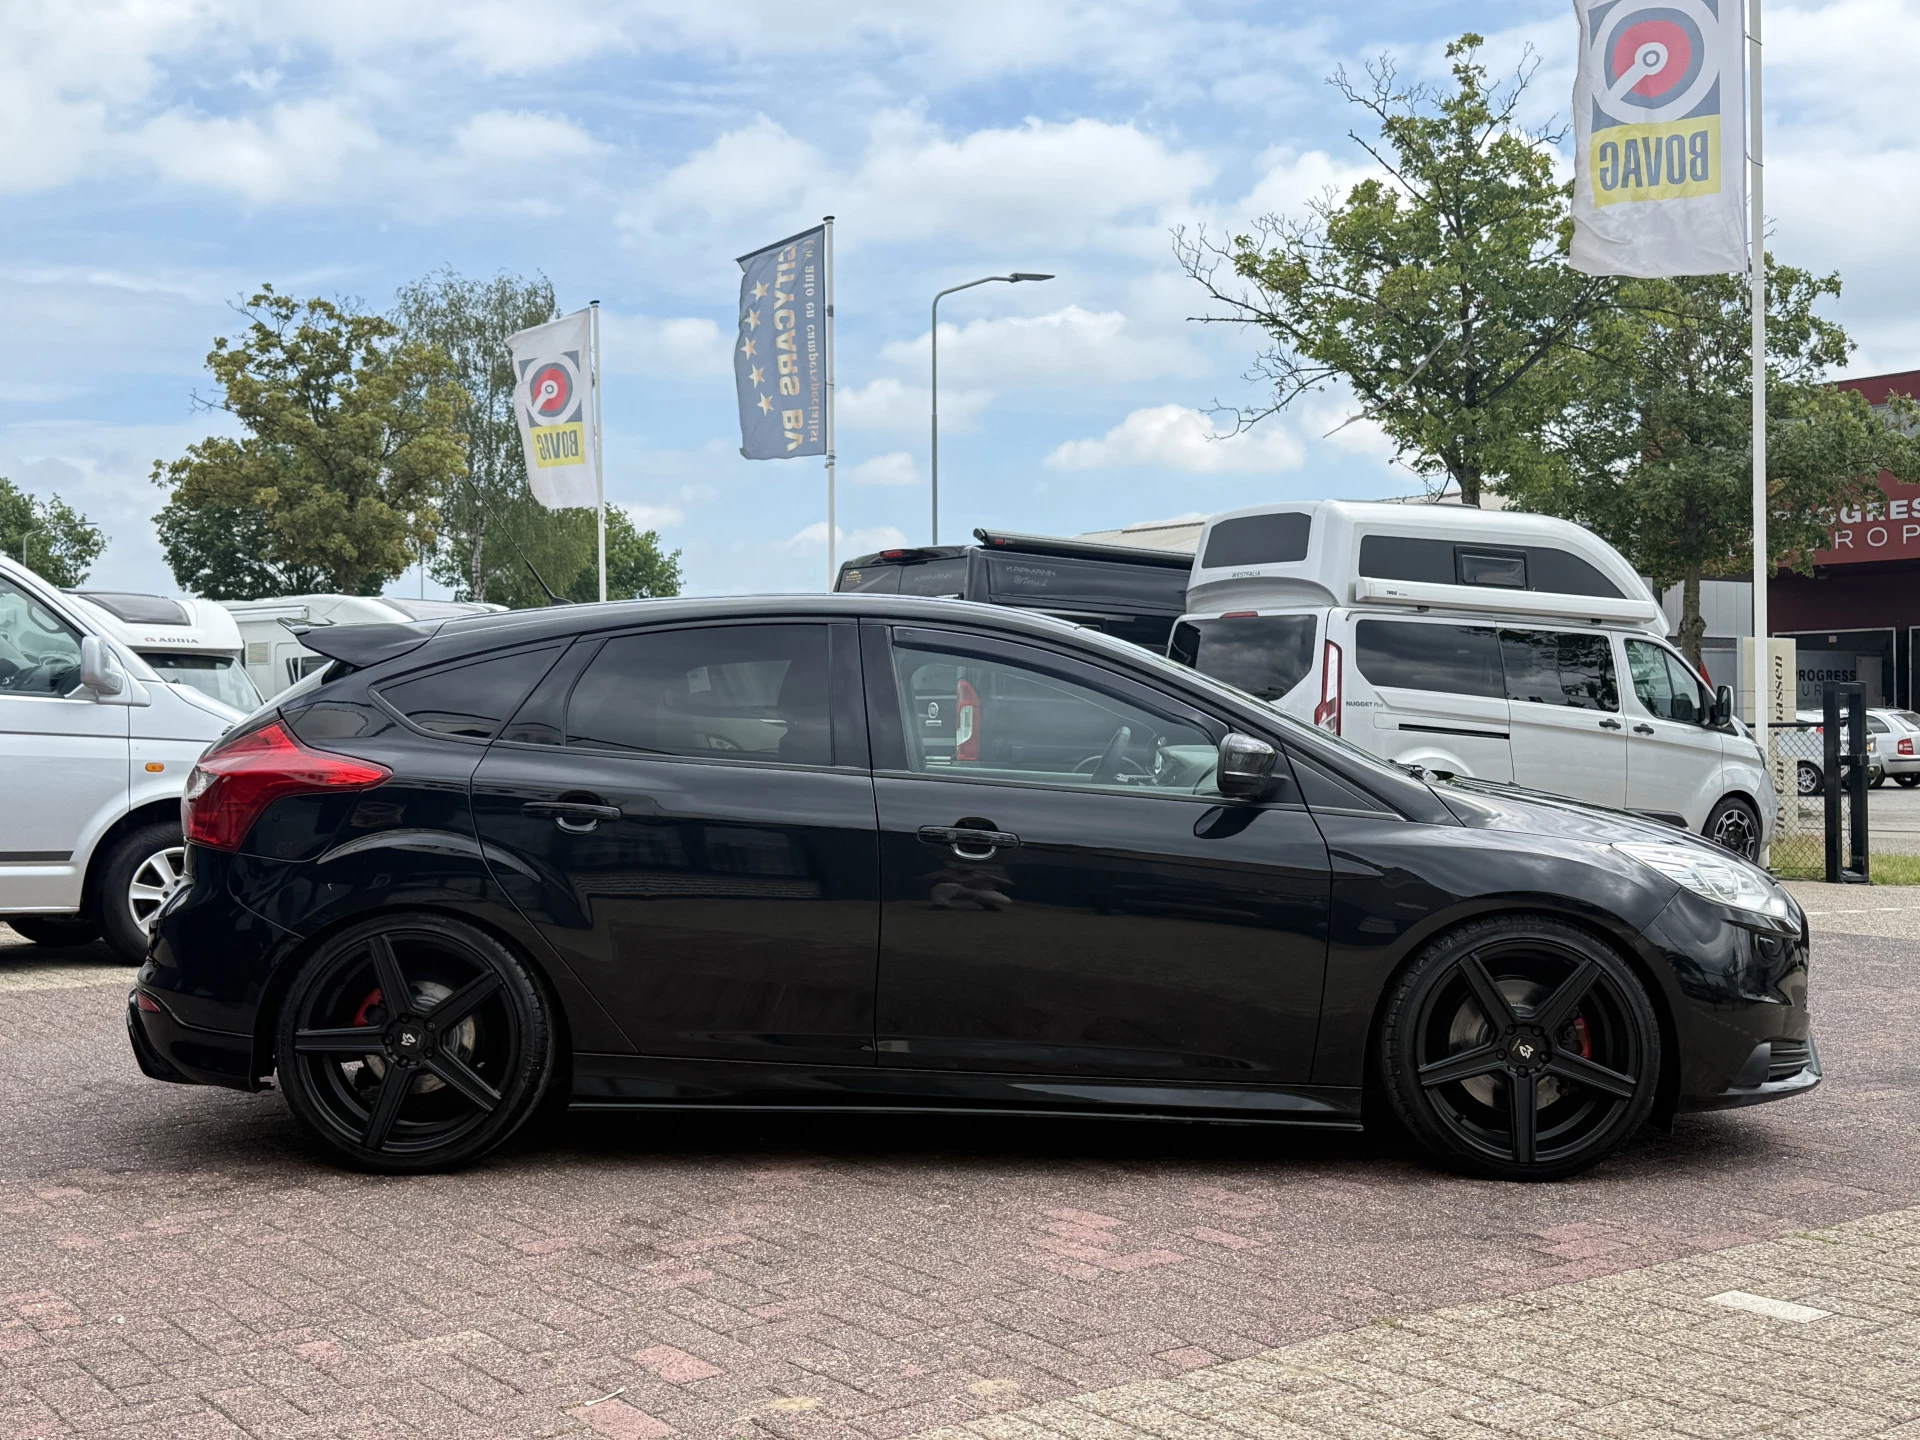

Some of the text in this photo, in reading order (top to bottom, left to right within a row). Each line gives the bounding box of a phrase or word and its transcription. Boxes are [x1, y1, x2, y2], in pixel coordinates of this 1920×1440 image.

[1005, 565, 1056, 577] KARMANN
[1796, 669, 1857, 681] ROGRESS
[1346, 700, 1373, 708] NUGGET
[1774, 748, 1785, 795] Car
